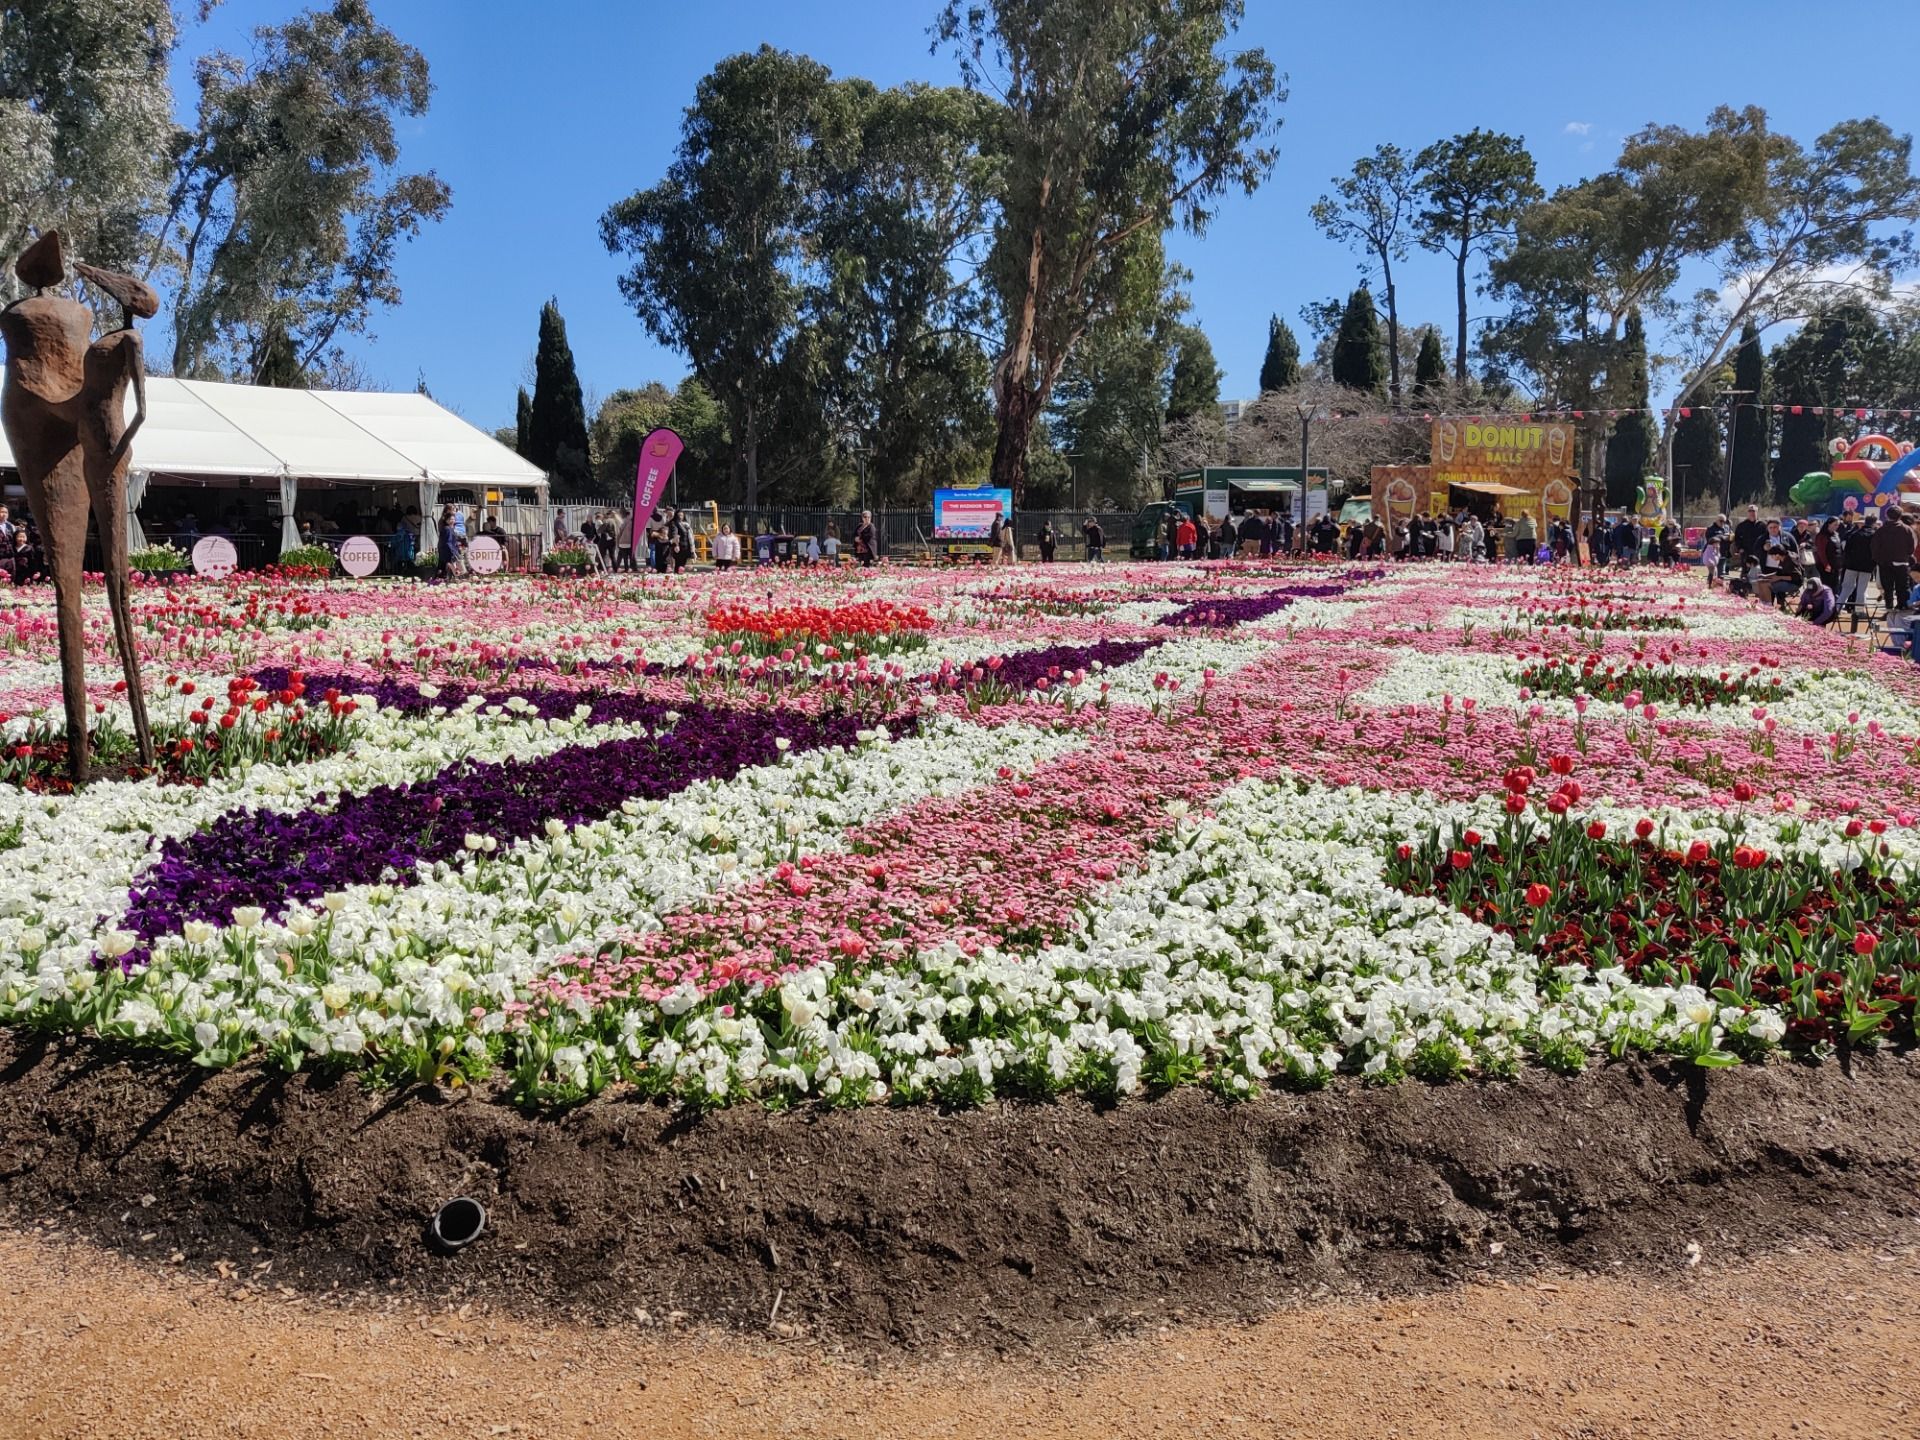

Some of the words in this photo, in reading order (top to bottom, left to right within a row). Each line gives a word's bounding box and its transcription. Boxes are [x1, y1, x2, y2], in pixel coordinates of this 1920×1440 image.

[1465, 424, 1544, 449] DONUT
[1486, 452, 1522, 464] BALLS
[1439, 472, 1469, 481] DONUT
[1471, 472, 1500, 483] BALLS
[641, 468, 659, 507] COFFEE
[1504, 495, 1538, 507] DONUT
[342, 551, 378, 562] COFFEE
[470, 551, 501, 561] SPRITZ
